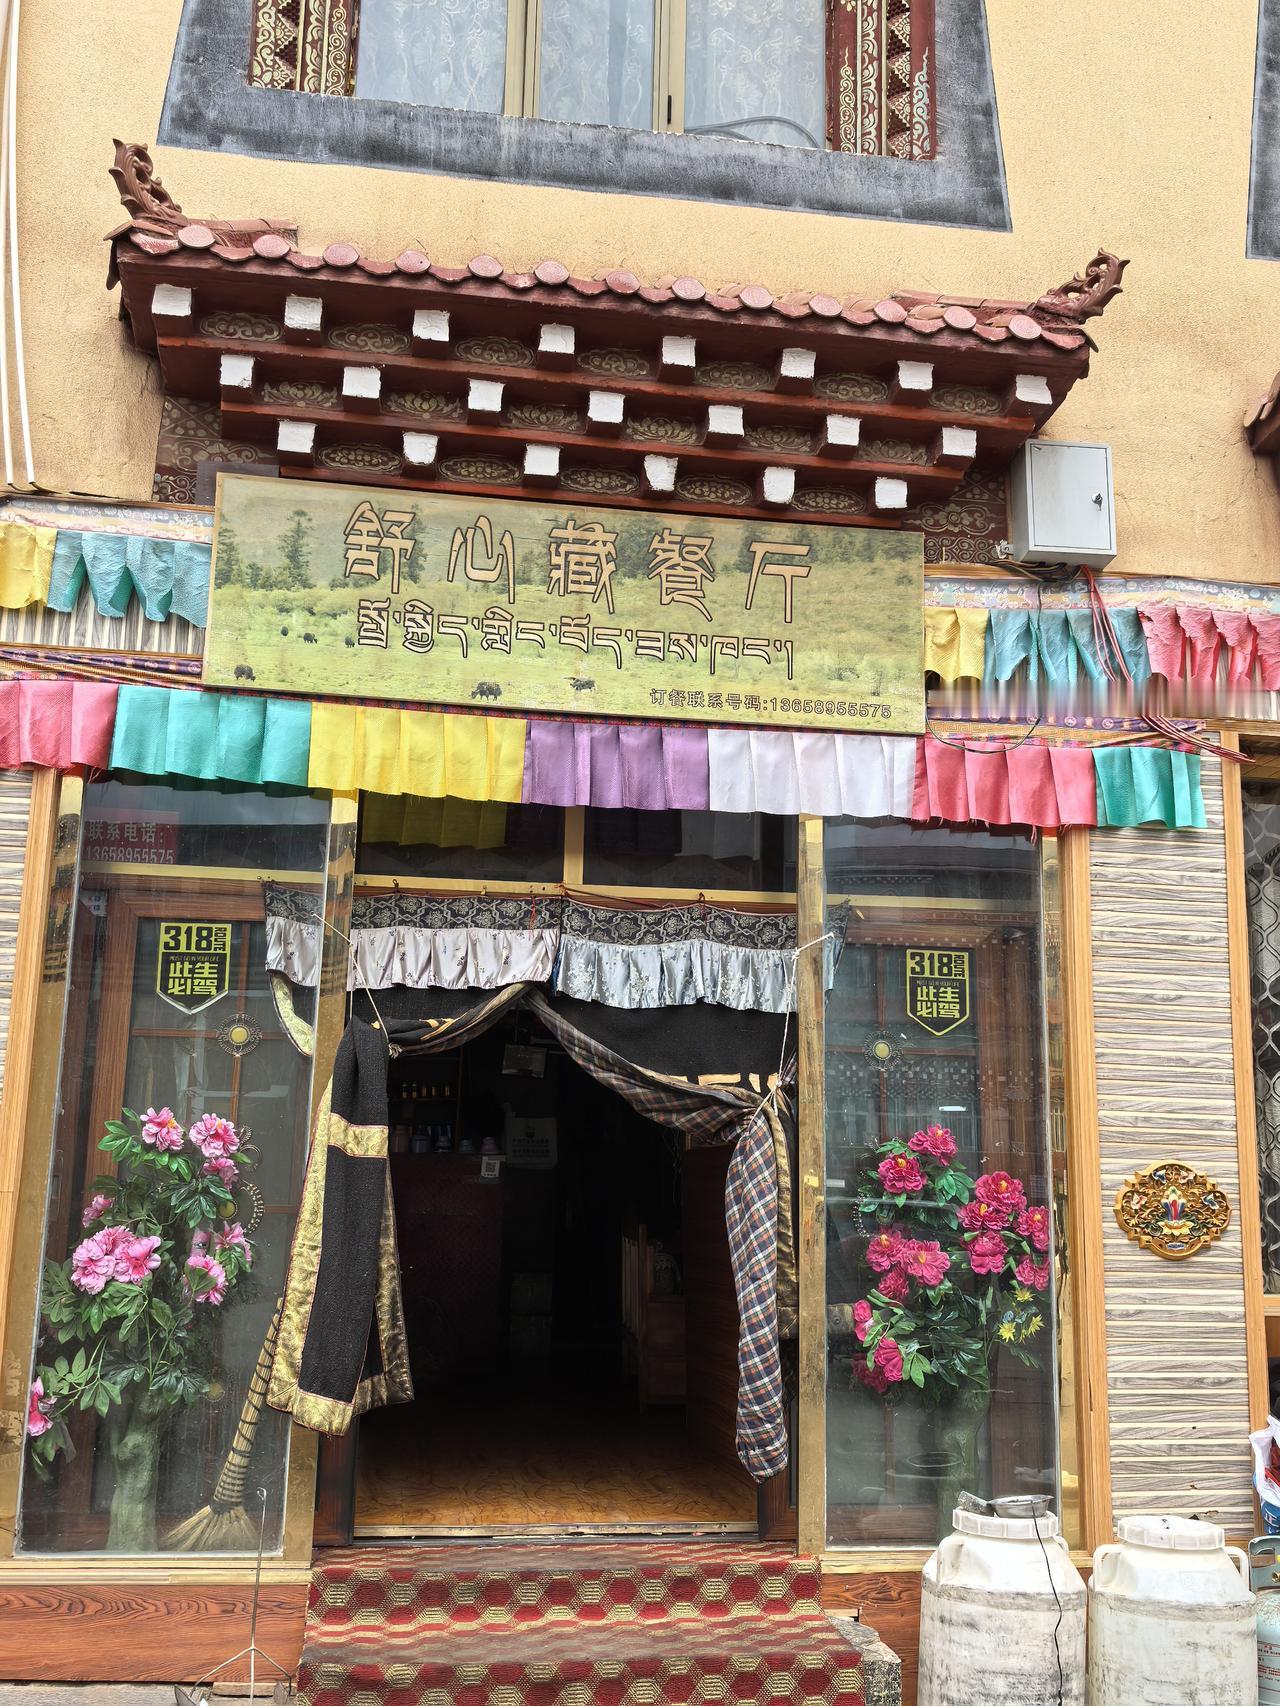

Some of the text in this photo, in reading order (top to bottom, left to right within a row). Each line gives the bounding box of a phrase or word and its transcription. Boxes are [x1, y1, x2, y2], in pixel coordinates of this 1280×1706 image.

[343, 501, 811, 623] 舒心藏餐厅
[163, 926, 213, 951] 318
[213, 927, 227, 952] ROUTE
[169, 961, 218, 978] 此生
[910, 952, 953, 976] 318
[953, 954, 965, 978] ROUTE
[917, 986, 960, 1002] 此生
